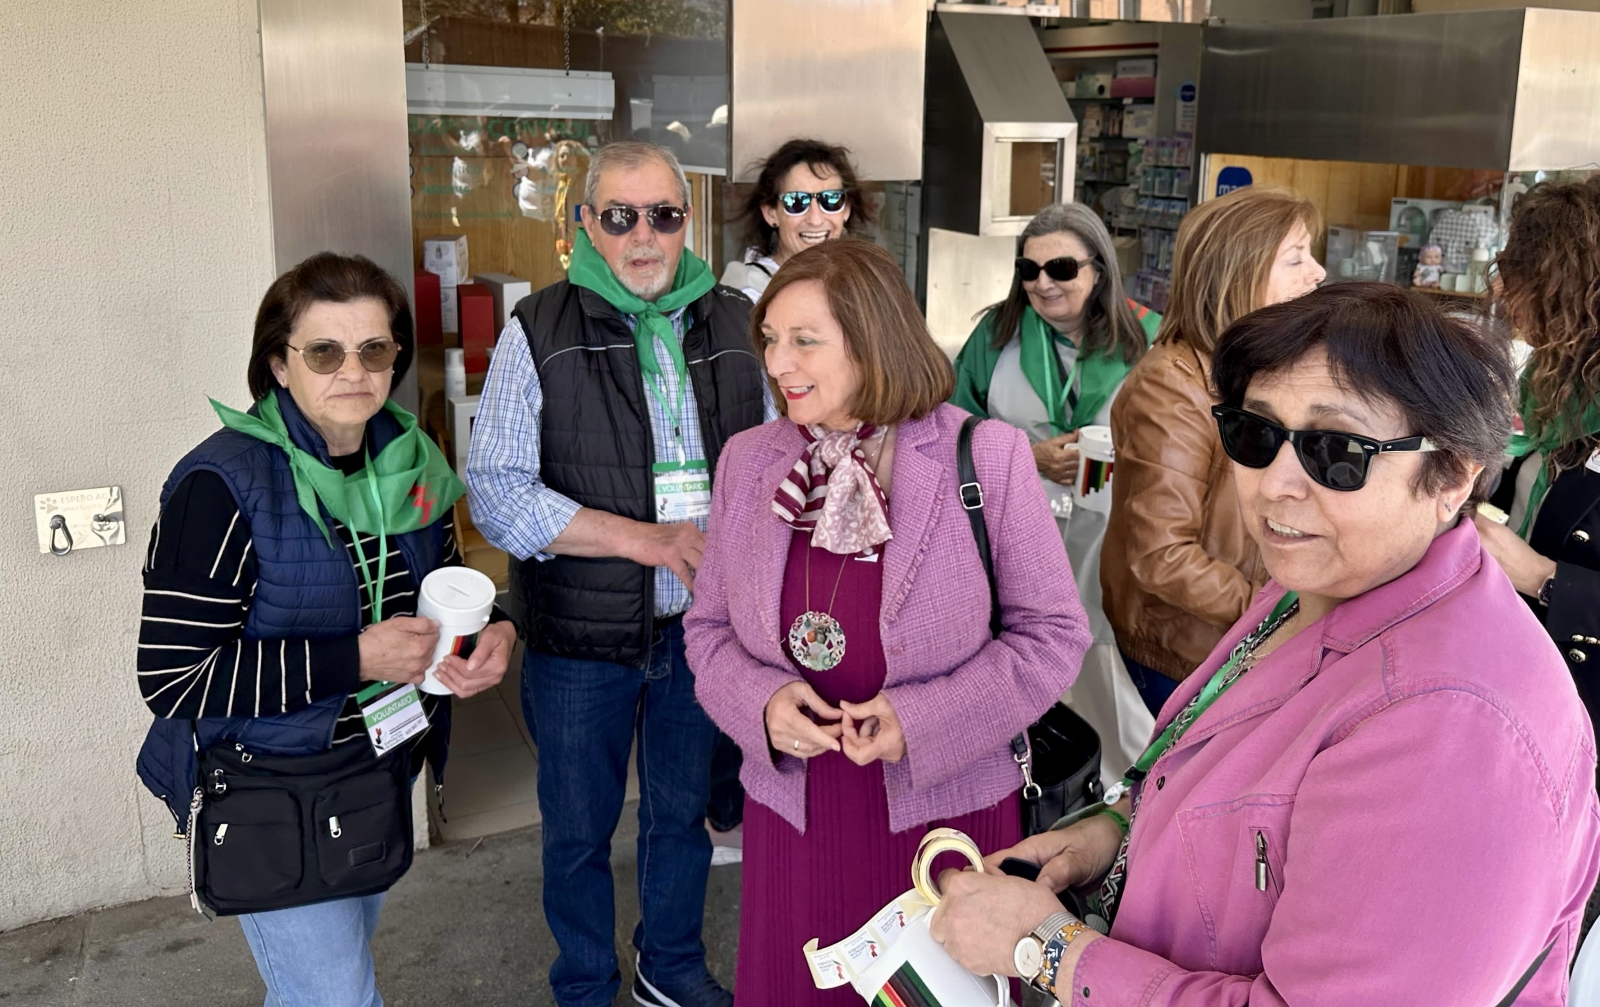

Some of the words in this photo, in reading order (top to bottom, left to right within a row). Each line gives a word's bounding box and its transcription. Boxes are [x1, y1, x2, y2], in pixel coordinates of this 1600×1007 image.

[487, 118, 593, 140] CONTROL
[662, 482, 705, 493] VOLUNTARIO
[61, 494, 93, 504] ESPERO
[371, 695, 412, 722] VOLUNTARIO
